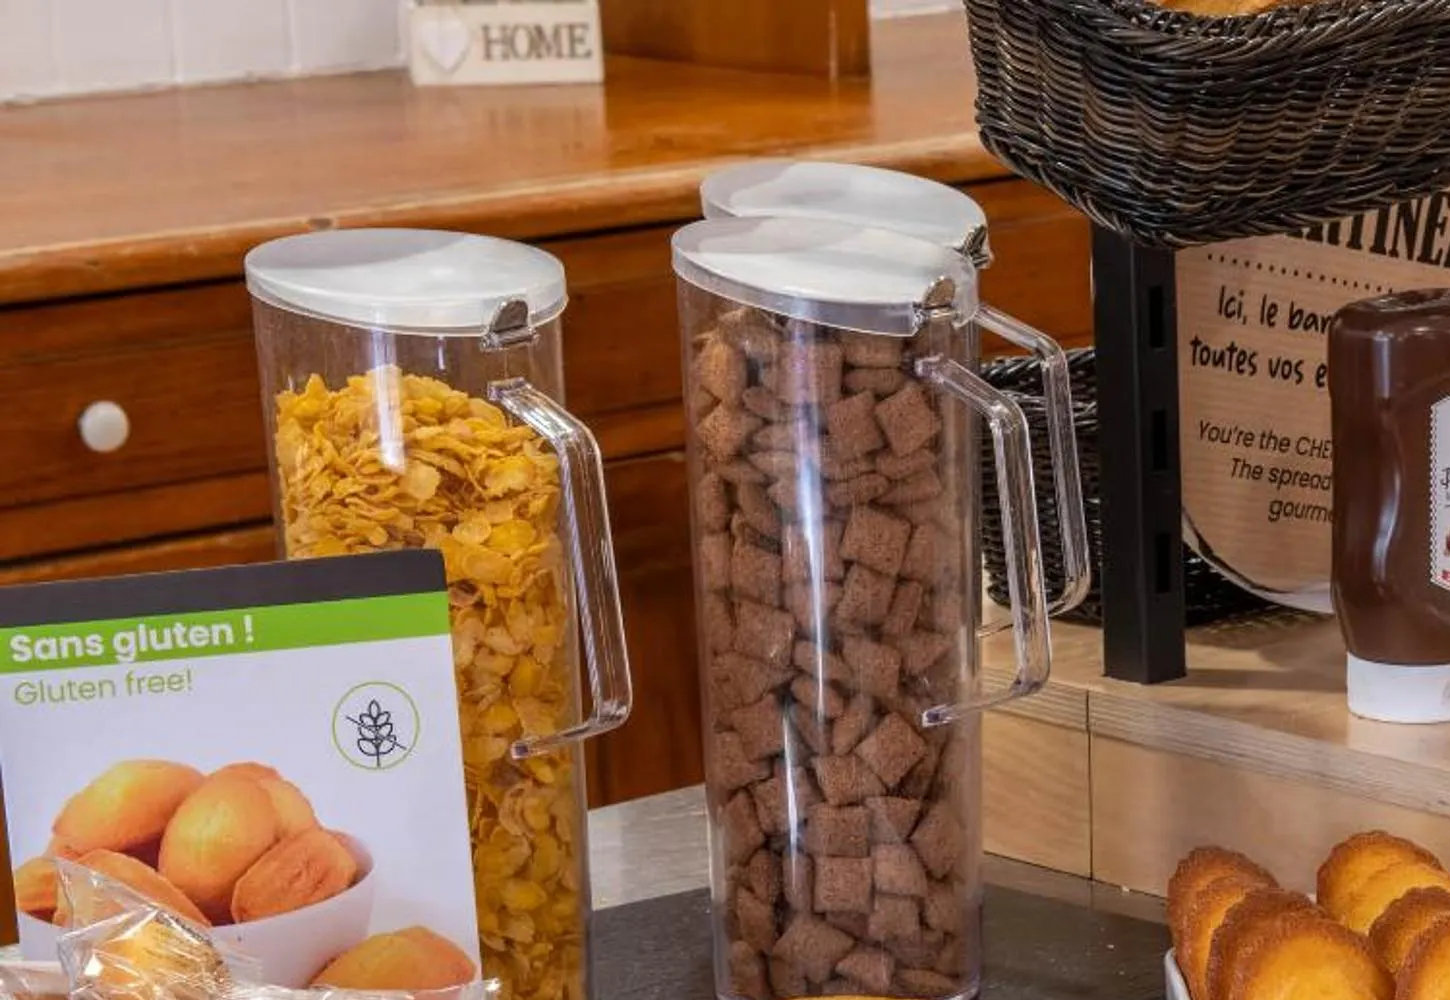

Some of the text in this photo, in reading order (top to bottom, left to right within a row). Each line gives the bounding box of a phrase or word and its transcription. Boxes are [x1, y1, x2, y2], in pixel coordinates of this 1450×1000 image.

[481, 23, 592, 61] HOME
[1217, 285, 1248, 326] Ici,
[1259, 293, 1279, 329] le
[1189, 334, 1258, 377] toutes
[1267, 355, 1305, 386] vos
[1198, 419, 1333, 460] You're the CHE
[1230, 457, 1264, 481] The
[9, 614, 255, 664] Sans gluten !
[14, 667, 194, 706] Gluten free!
